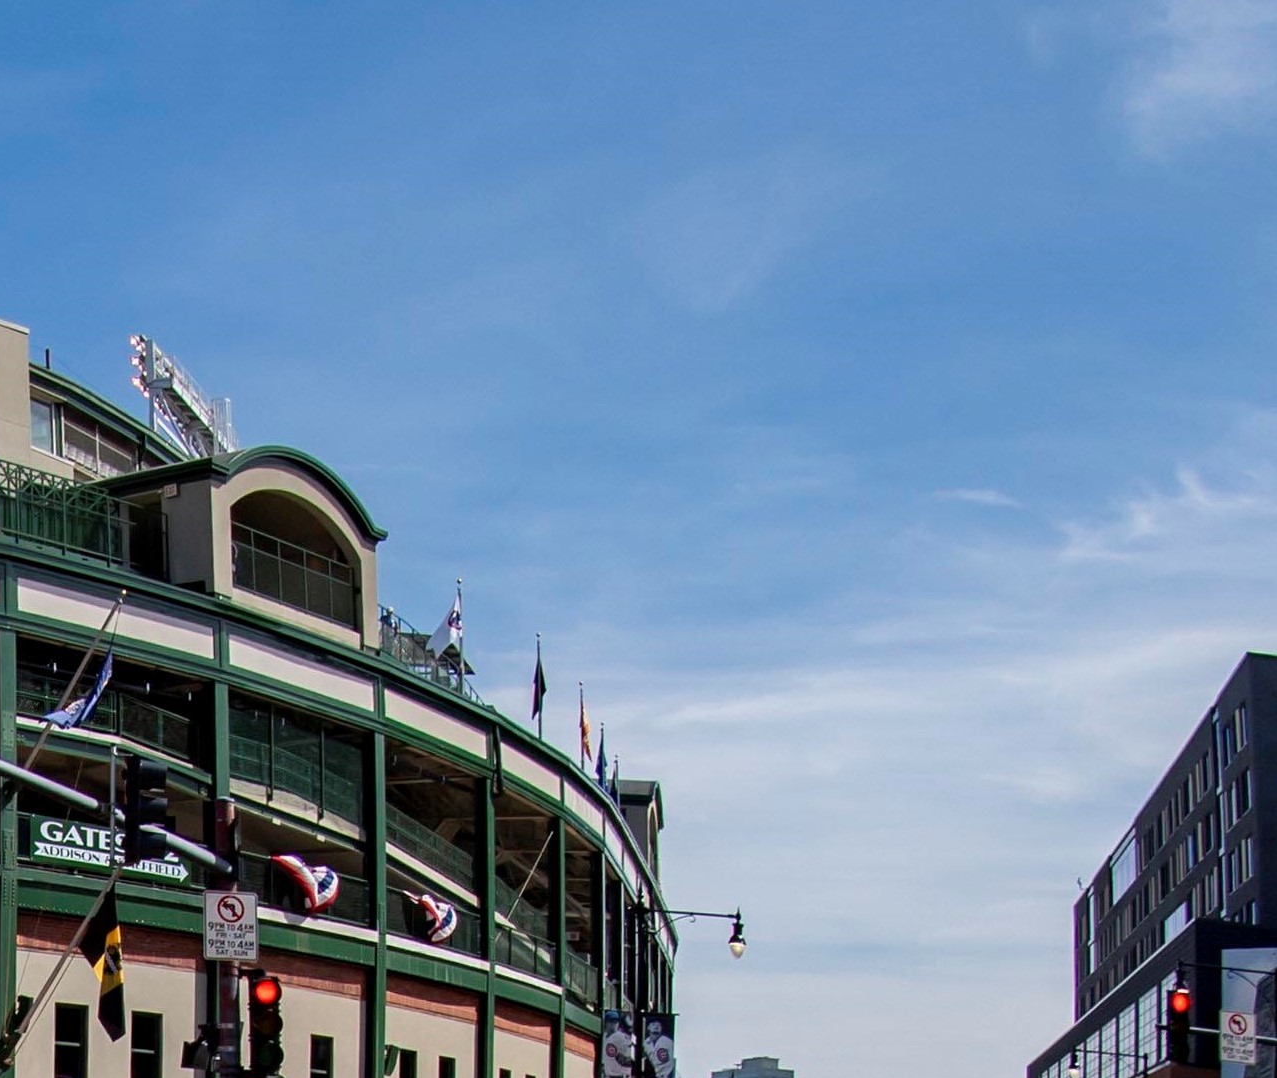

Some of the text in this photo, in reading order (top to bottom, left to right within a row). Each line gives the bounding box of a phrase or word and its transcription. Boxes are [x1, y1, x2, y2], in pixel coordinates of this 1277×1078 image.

[41, 844, 101, 863] ADDISON
[227, 923, 236, 931] TO
[227, 940, 236, 949] TO
